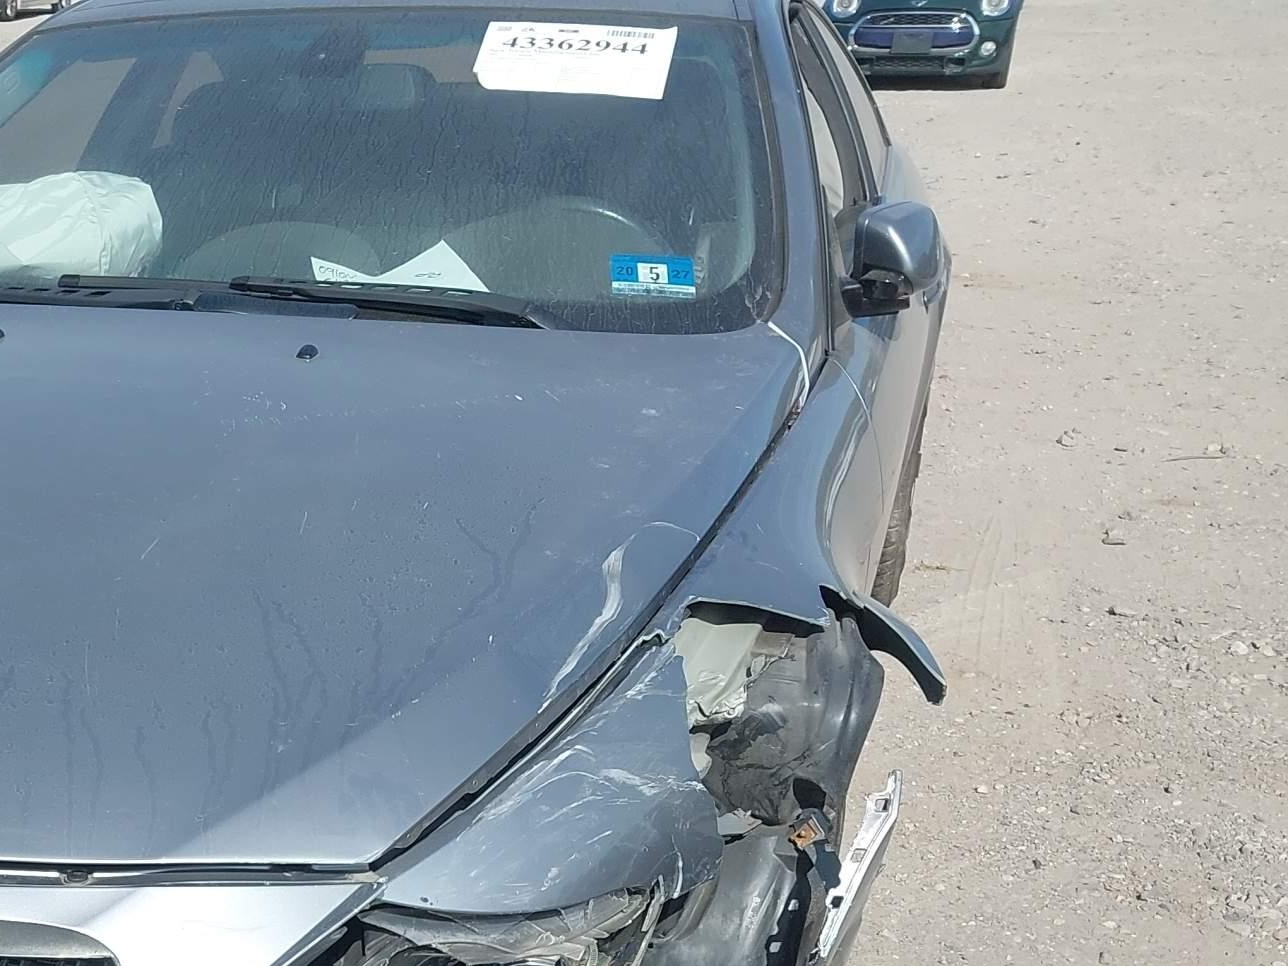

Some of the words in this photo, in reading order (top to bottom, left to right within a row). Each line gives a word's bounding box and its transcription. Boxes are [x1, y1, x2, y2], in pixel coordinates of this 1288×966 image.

[502, 36, 649, 55] 43362944
[615, 265, 634, 276] 20
[648, 266, 661, 282] 5
[671, 269, 690, 280] 27
